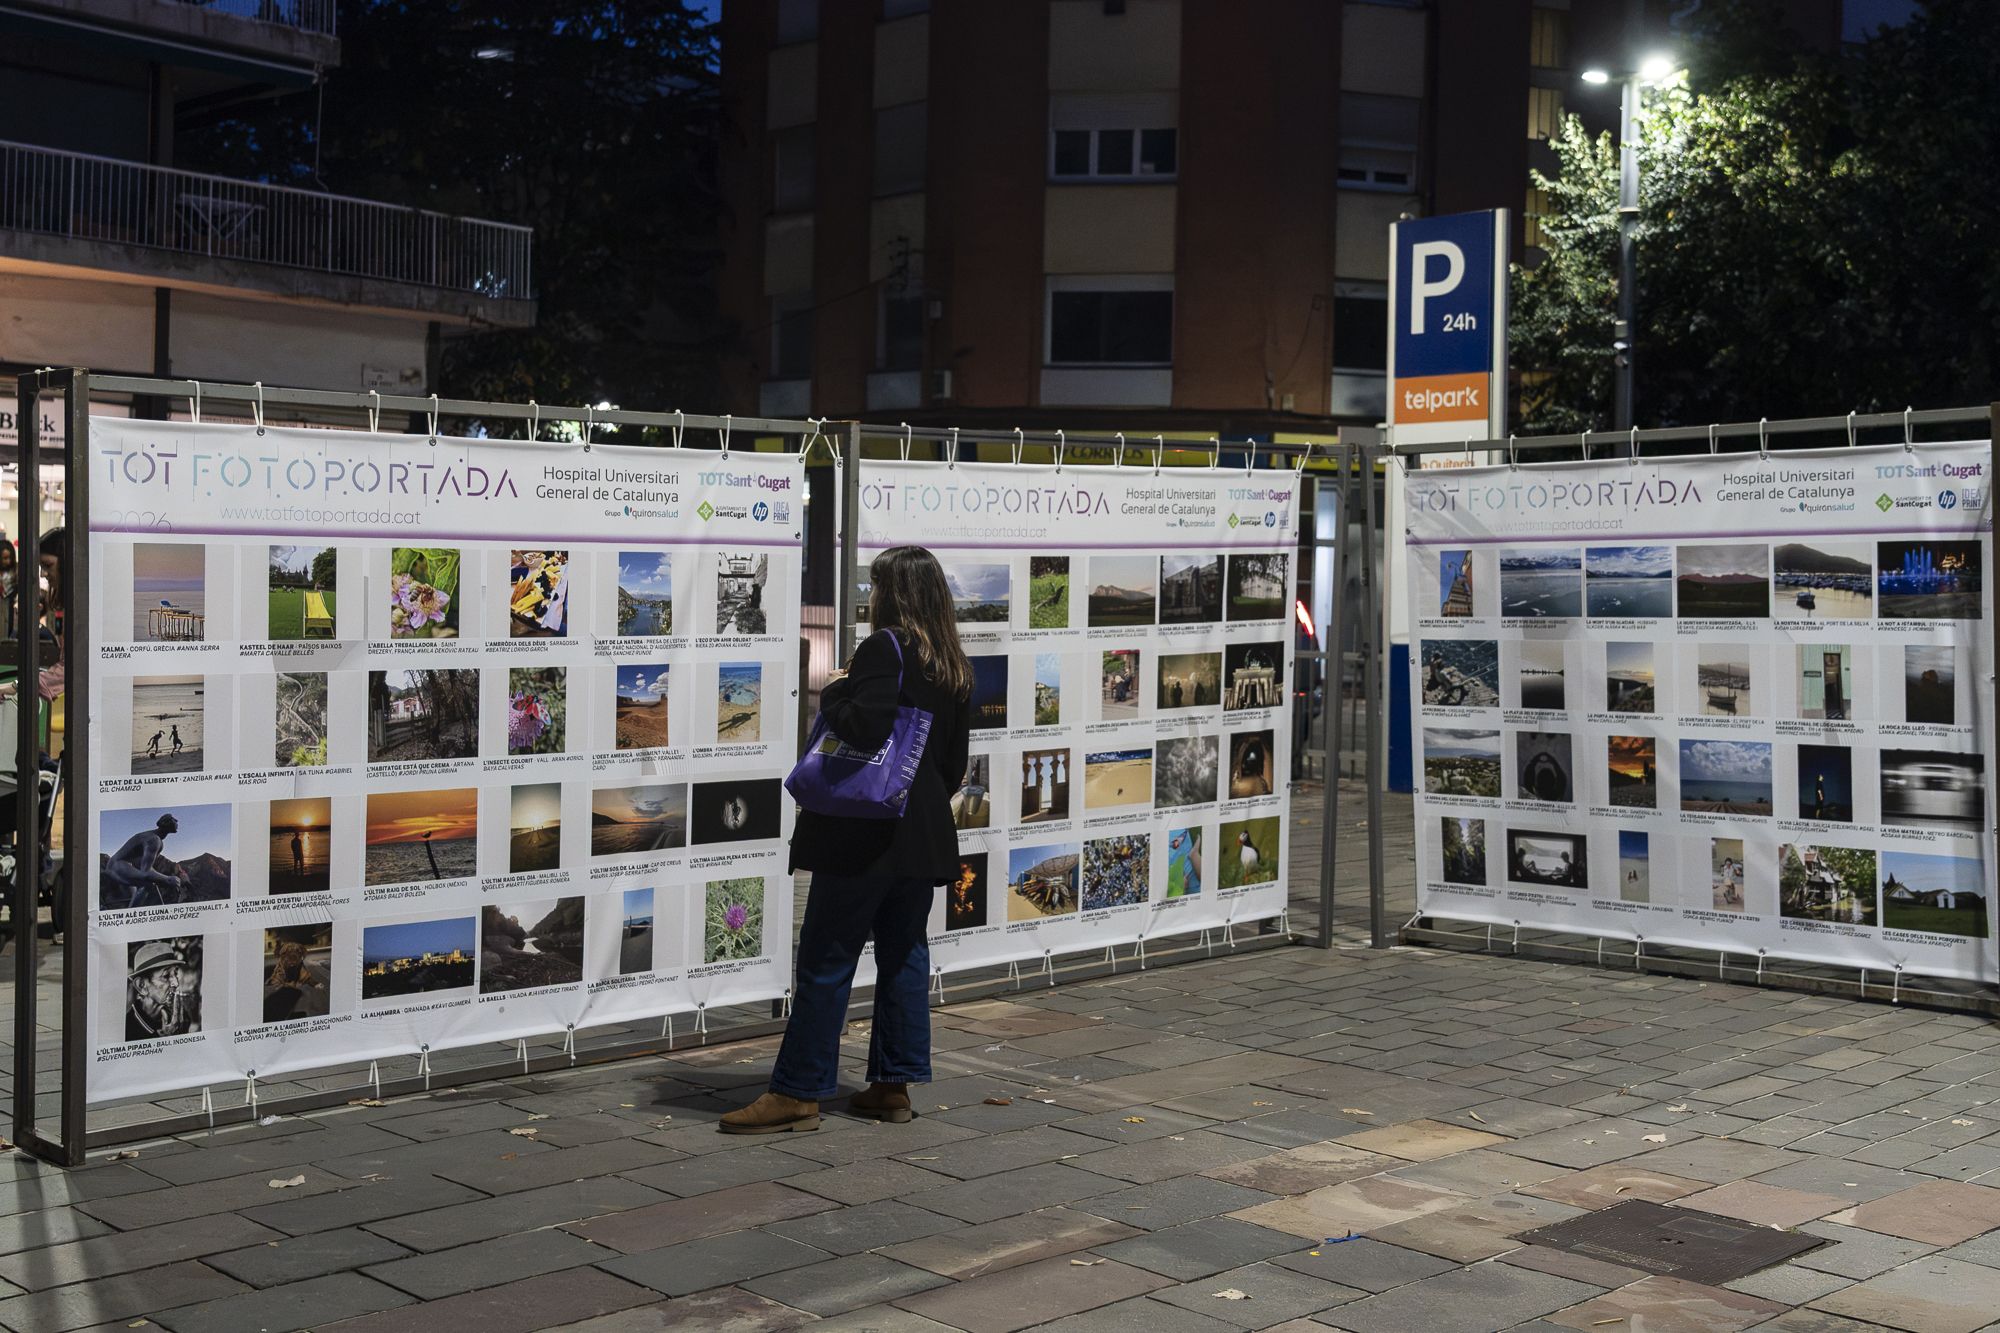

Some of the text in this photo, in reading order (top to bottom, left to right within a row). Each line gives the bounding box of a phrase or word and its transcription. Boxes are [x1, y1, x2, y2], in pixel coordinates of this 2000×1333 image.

[1411, 240, 1465, 335] P
[1443, 312, 1476, 332] 24h
[1405, 387, 1479, 413] telpark
[101, 450, 518, 499] TOT FOTOPORTADA
[543, 466, 679, 485] Hospital Universitari
[1723, 468, 1855, 486] Hospital Universitari
[536, 486, 679, 505] General de Catalunya
[904, 485, 1110, 515] FOTOPORTADA
[1126, 488, 1216, 501] Hospital Universitari
[1416, 480, 1702, 512] TOT FOTOPORTADA
[1716, 485, 1855, 501] General de Catalunya
[1121, 503, 1216, 517] General de Catalunya
[370, 1009, 400, 1017] ALHAMBRA
[128, 1043, 151, 1051] PIPADA
